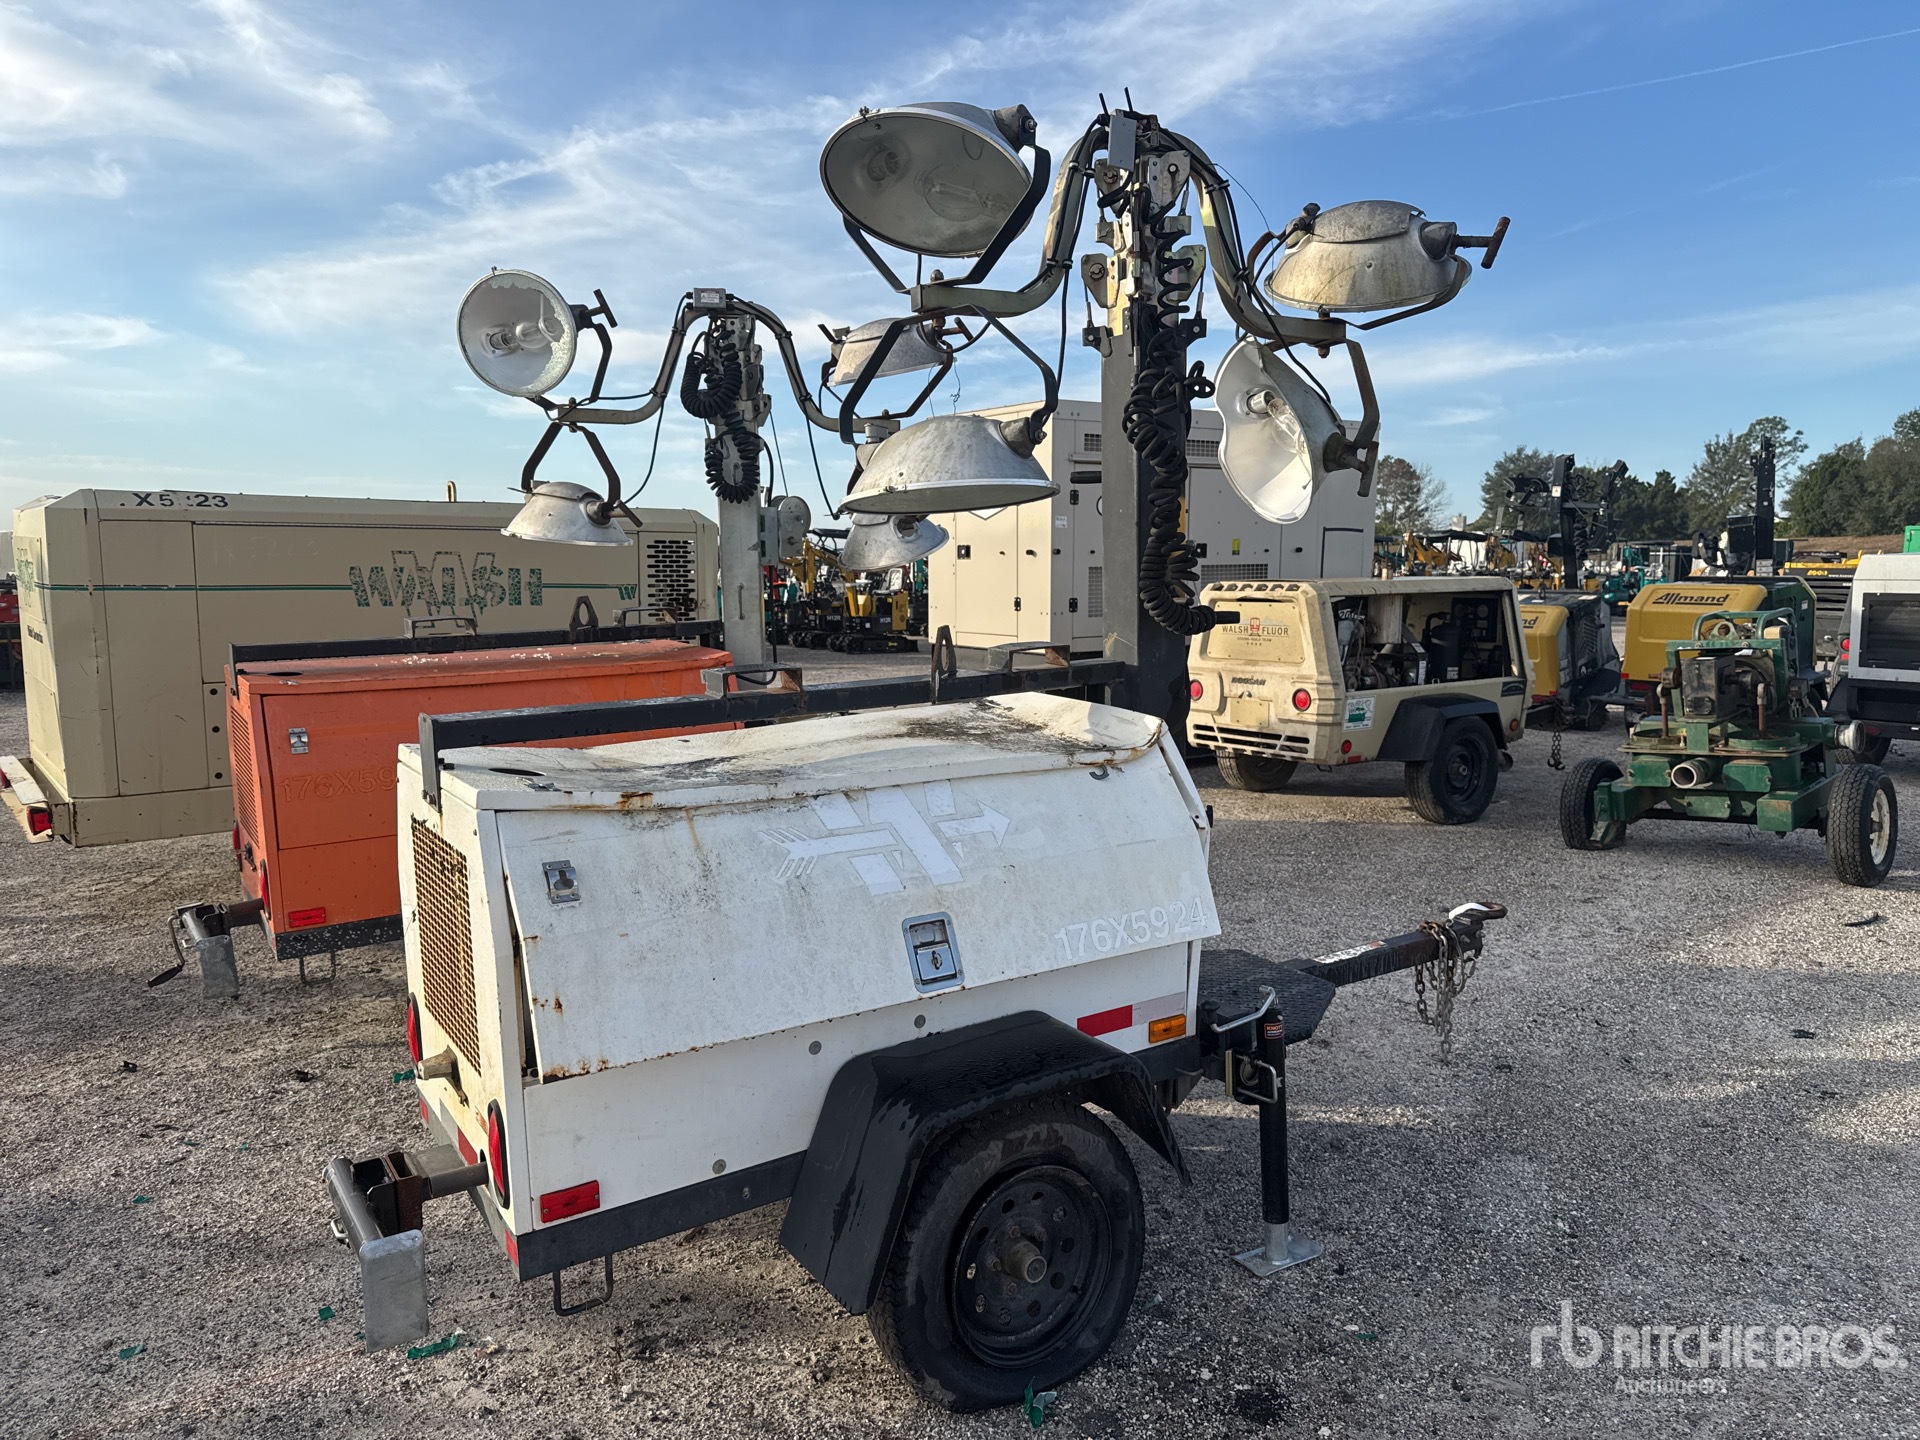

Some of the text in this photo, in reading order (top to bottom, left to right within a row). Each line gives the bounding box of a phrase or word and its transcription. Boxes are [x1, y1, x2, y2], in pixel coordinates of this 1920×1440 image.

[1652, 592, 1731, 605] Allmand
[1221, 625, 1289, 636] WALSH FLUOR
[1053, 895, 1208, 961] 176X5924
